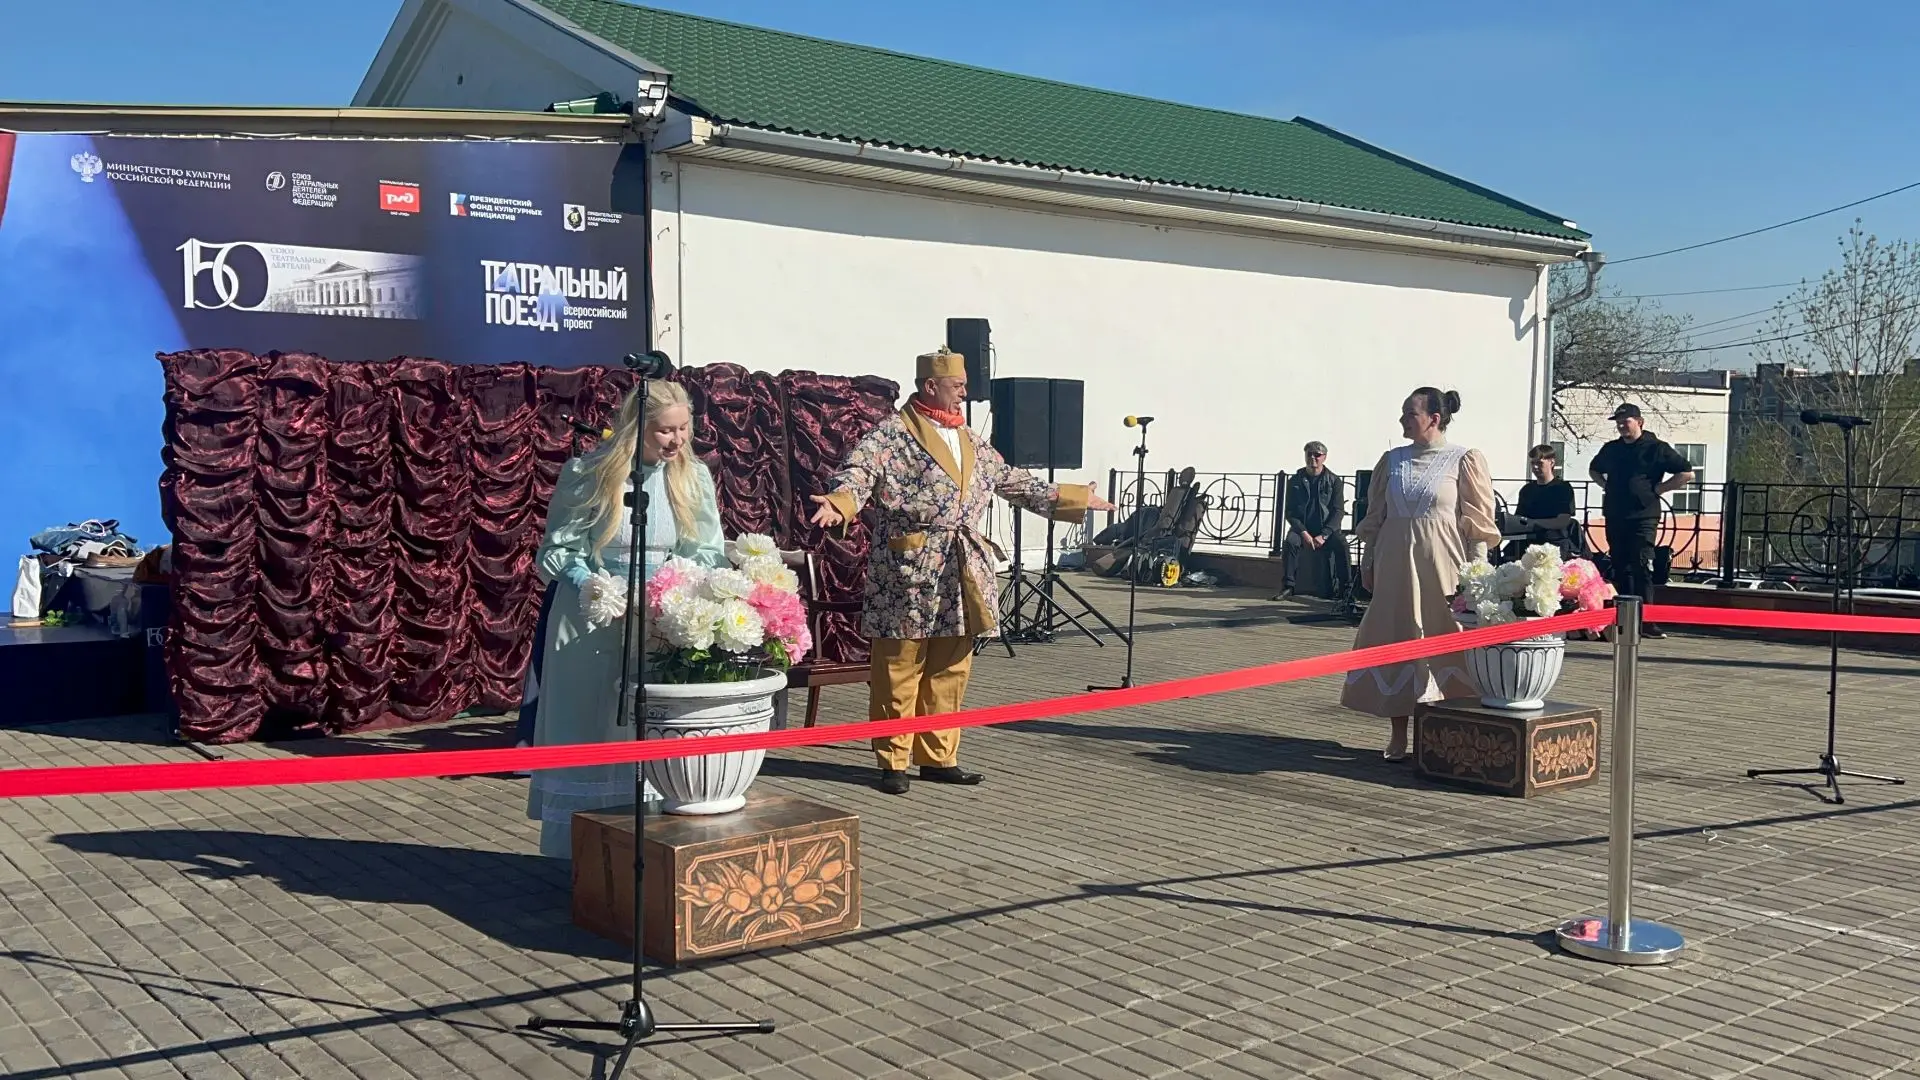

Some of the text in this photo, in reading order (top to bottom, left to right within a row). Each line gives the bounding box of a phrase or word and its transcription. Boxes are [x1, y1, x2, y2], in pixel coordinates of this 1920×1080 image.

[106, 162, 231, 181] МИНИСТЕРСТВО КУЛЬТУРЫ
[291, 172, 311, 181] СОЮЗ
[106, 171, 231, 190] РОССИЙСКОЙ ФЕДЕРАЦИИ
[292, 179, 339, 190] ТЕАТРАЛЬНЫХ
[292, 186, 327, 194] ДЕЯТЕЛЕЙ
[292, 191, 337, 202] РОССИЙСКОЙ
[292, 198, 334, 208] ФЕДЕРАЦИИ
[469, 194, 532, 208] ПРЕЗИДЕНТСКИЙ
[469, 203, 543, 216] ФОНД КУЛЬТУРНЫХ
[470, 210, 516, 221] ИНИЦИАТИВ
[270, 247, 295, 255] СОЮЗ
[271, 254, 327, 265] ТЕАТРАЛЬНЫХ
[175, 237, 269, 311] 150
[480, 259, 628, 302] ТЕАТРАЛЬНЫЙ
[485, 292, 559, 332] ПОЕЗД
[563, 305, 628, 319] всероссийский
[563, 318, 593, 331] проект
